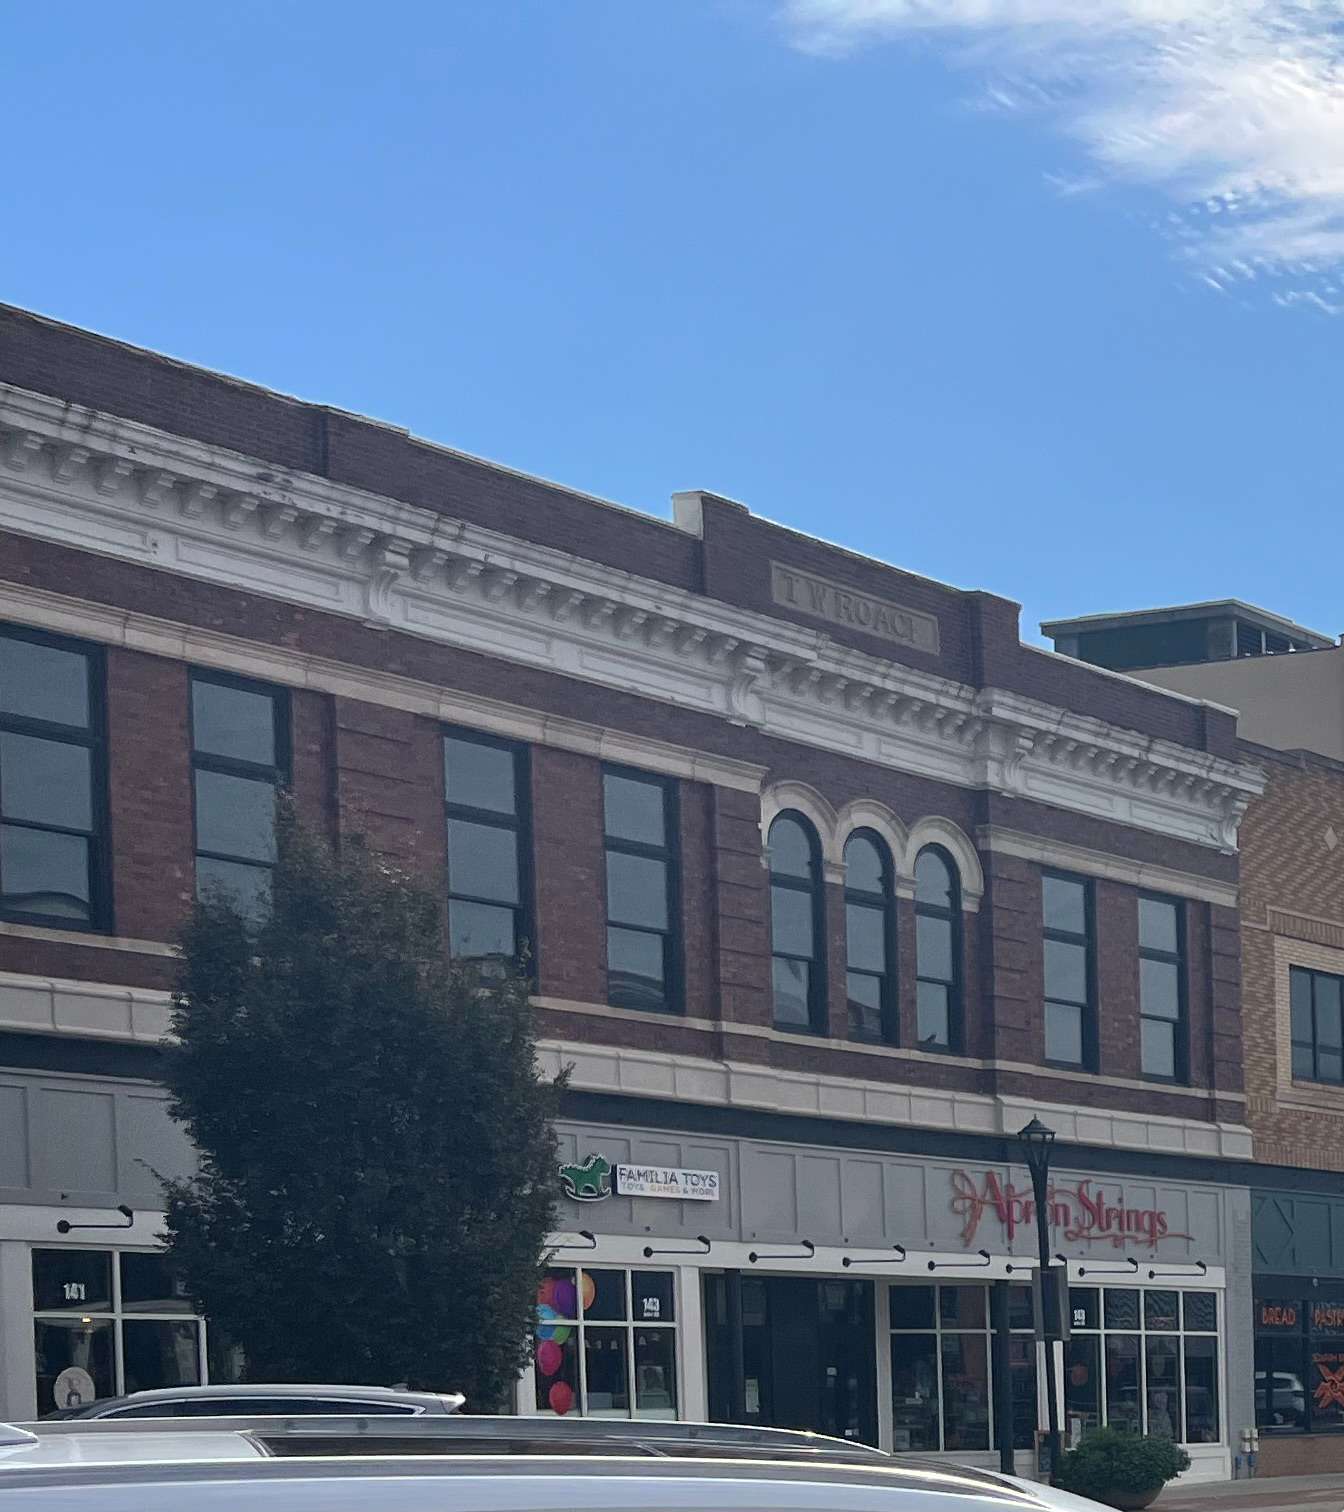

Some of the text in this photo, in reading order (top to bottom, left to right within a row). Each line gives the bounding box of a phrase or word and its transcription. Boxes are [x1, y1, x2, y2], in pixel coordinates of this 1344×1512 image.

[619, 1167, 718, 1189] FAMILIA TOYS
[952, 1169, 1178, 1248] Aprn Strings
[1262, 1306, 1296, 1325] BREAD
